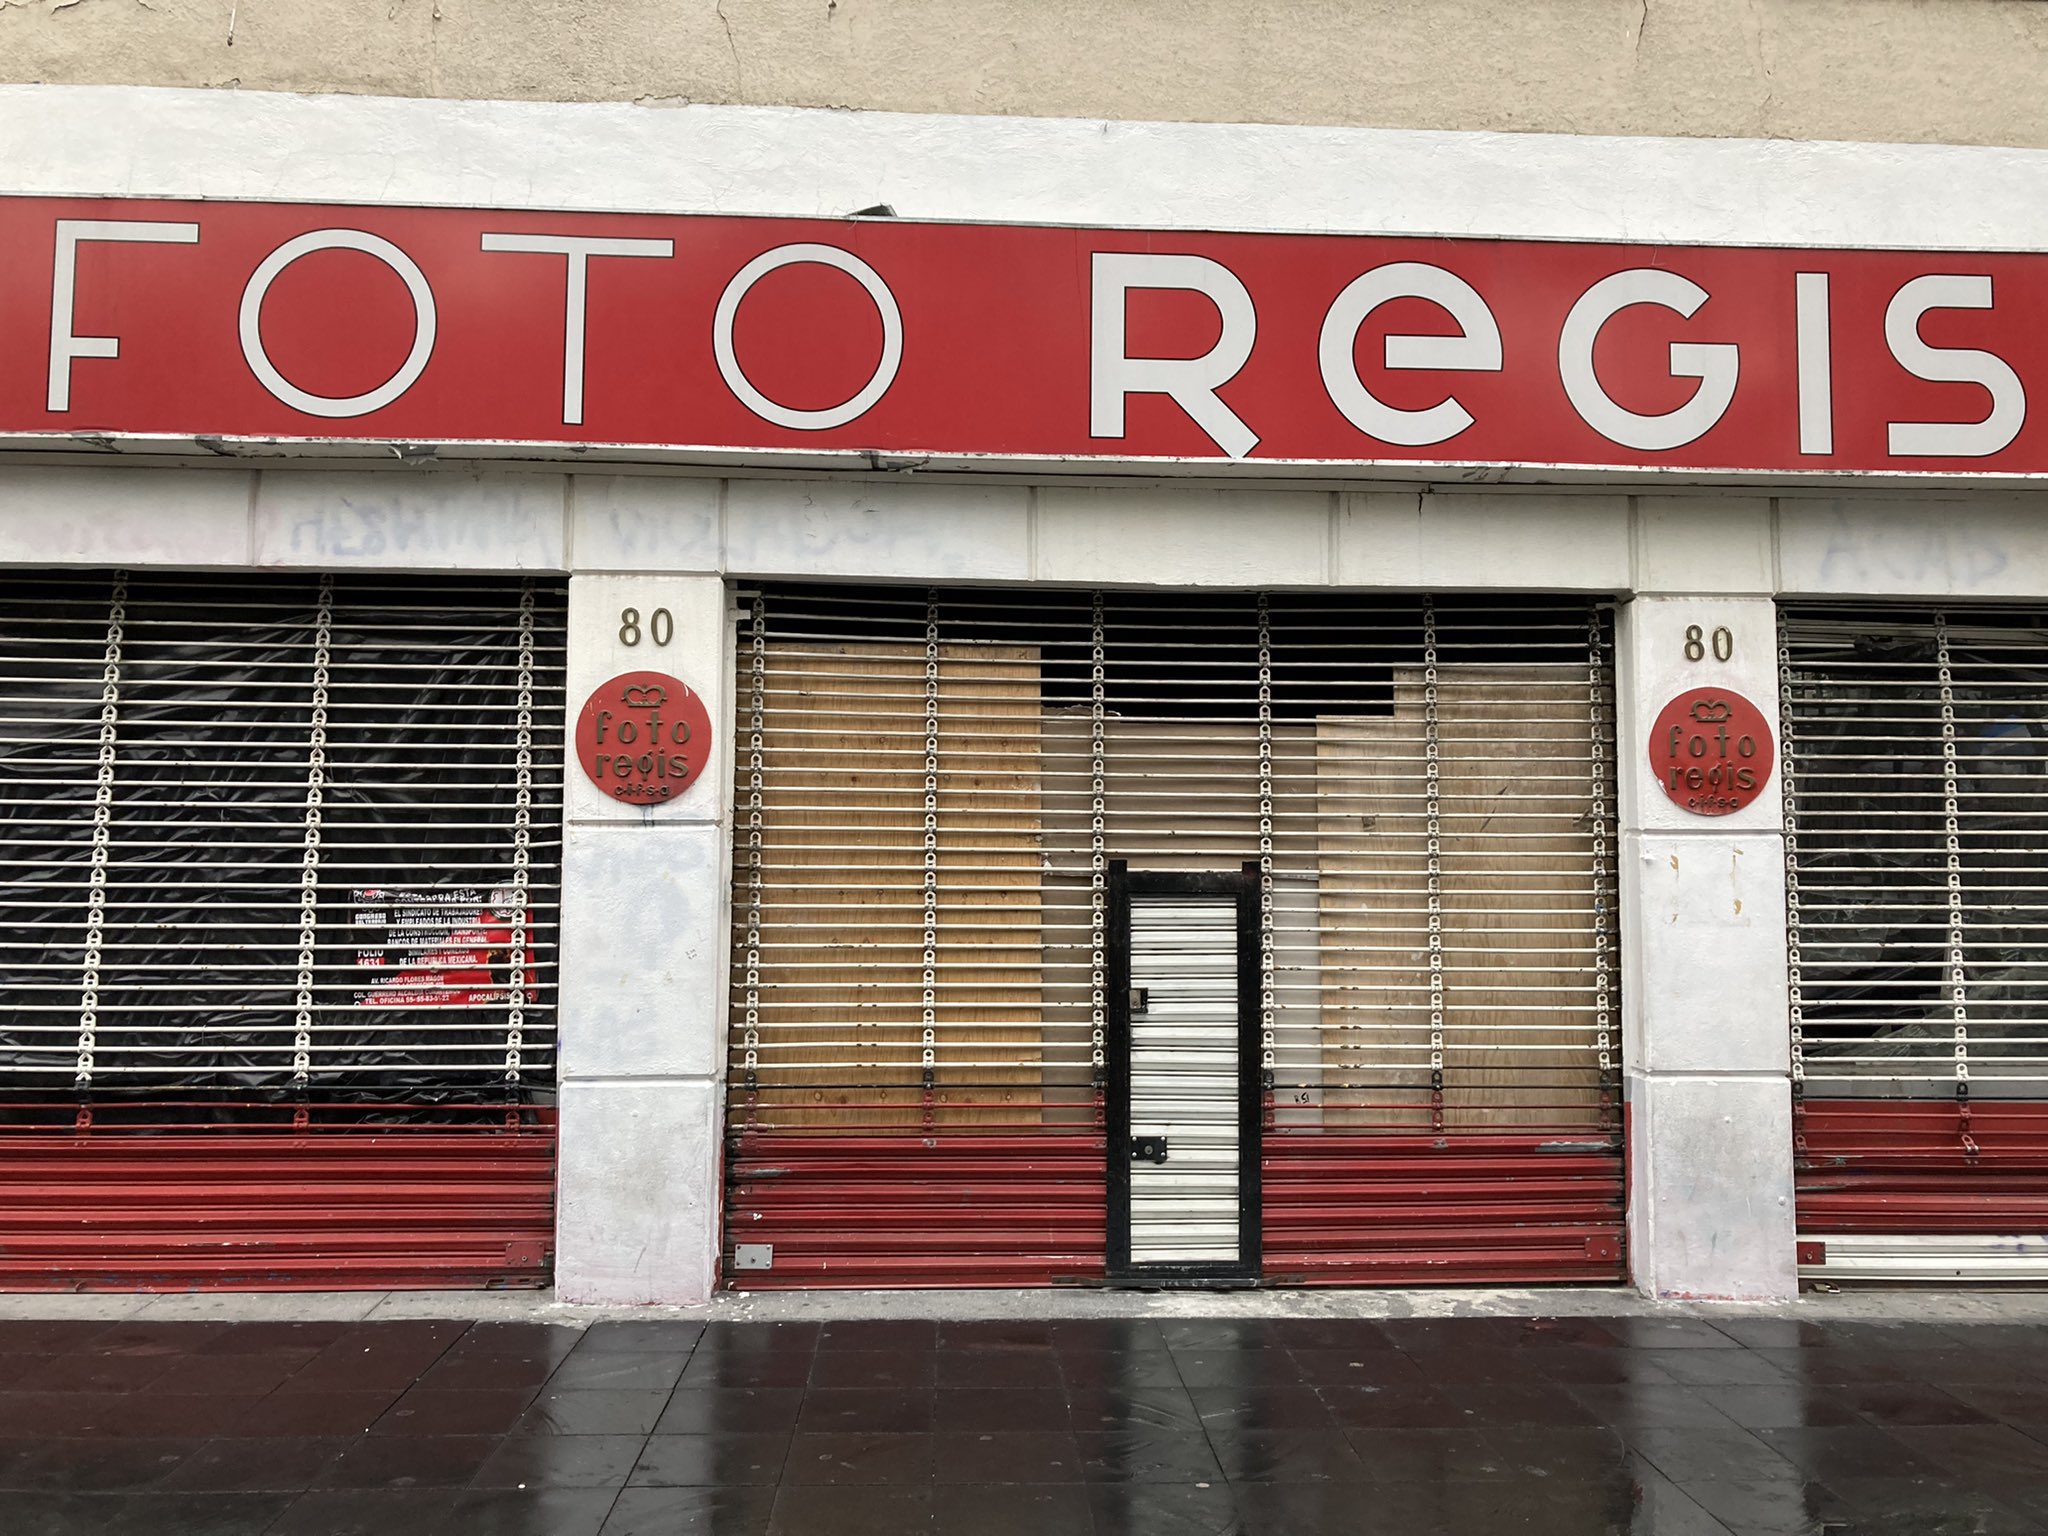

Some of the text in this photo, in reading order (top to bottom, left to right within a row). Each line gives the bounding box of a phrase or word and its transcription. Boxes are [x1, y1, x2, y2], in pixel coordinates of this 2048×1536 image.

[47, 219, 903, 431] FOTO
[619, 607, 674, 647] 80
[1684, 624, 1734, 662] 80
[596, 709, 692, 745] foto
[1669, 724, 1757, 758] foto
[596, 747, 690, 781] regis
[1669, 760, 1757, 792] regis
